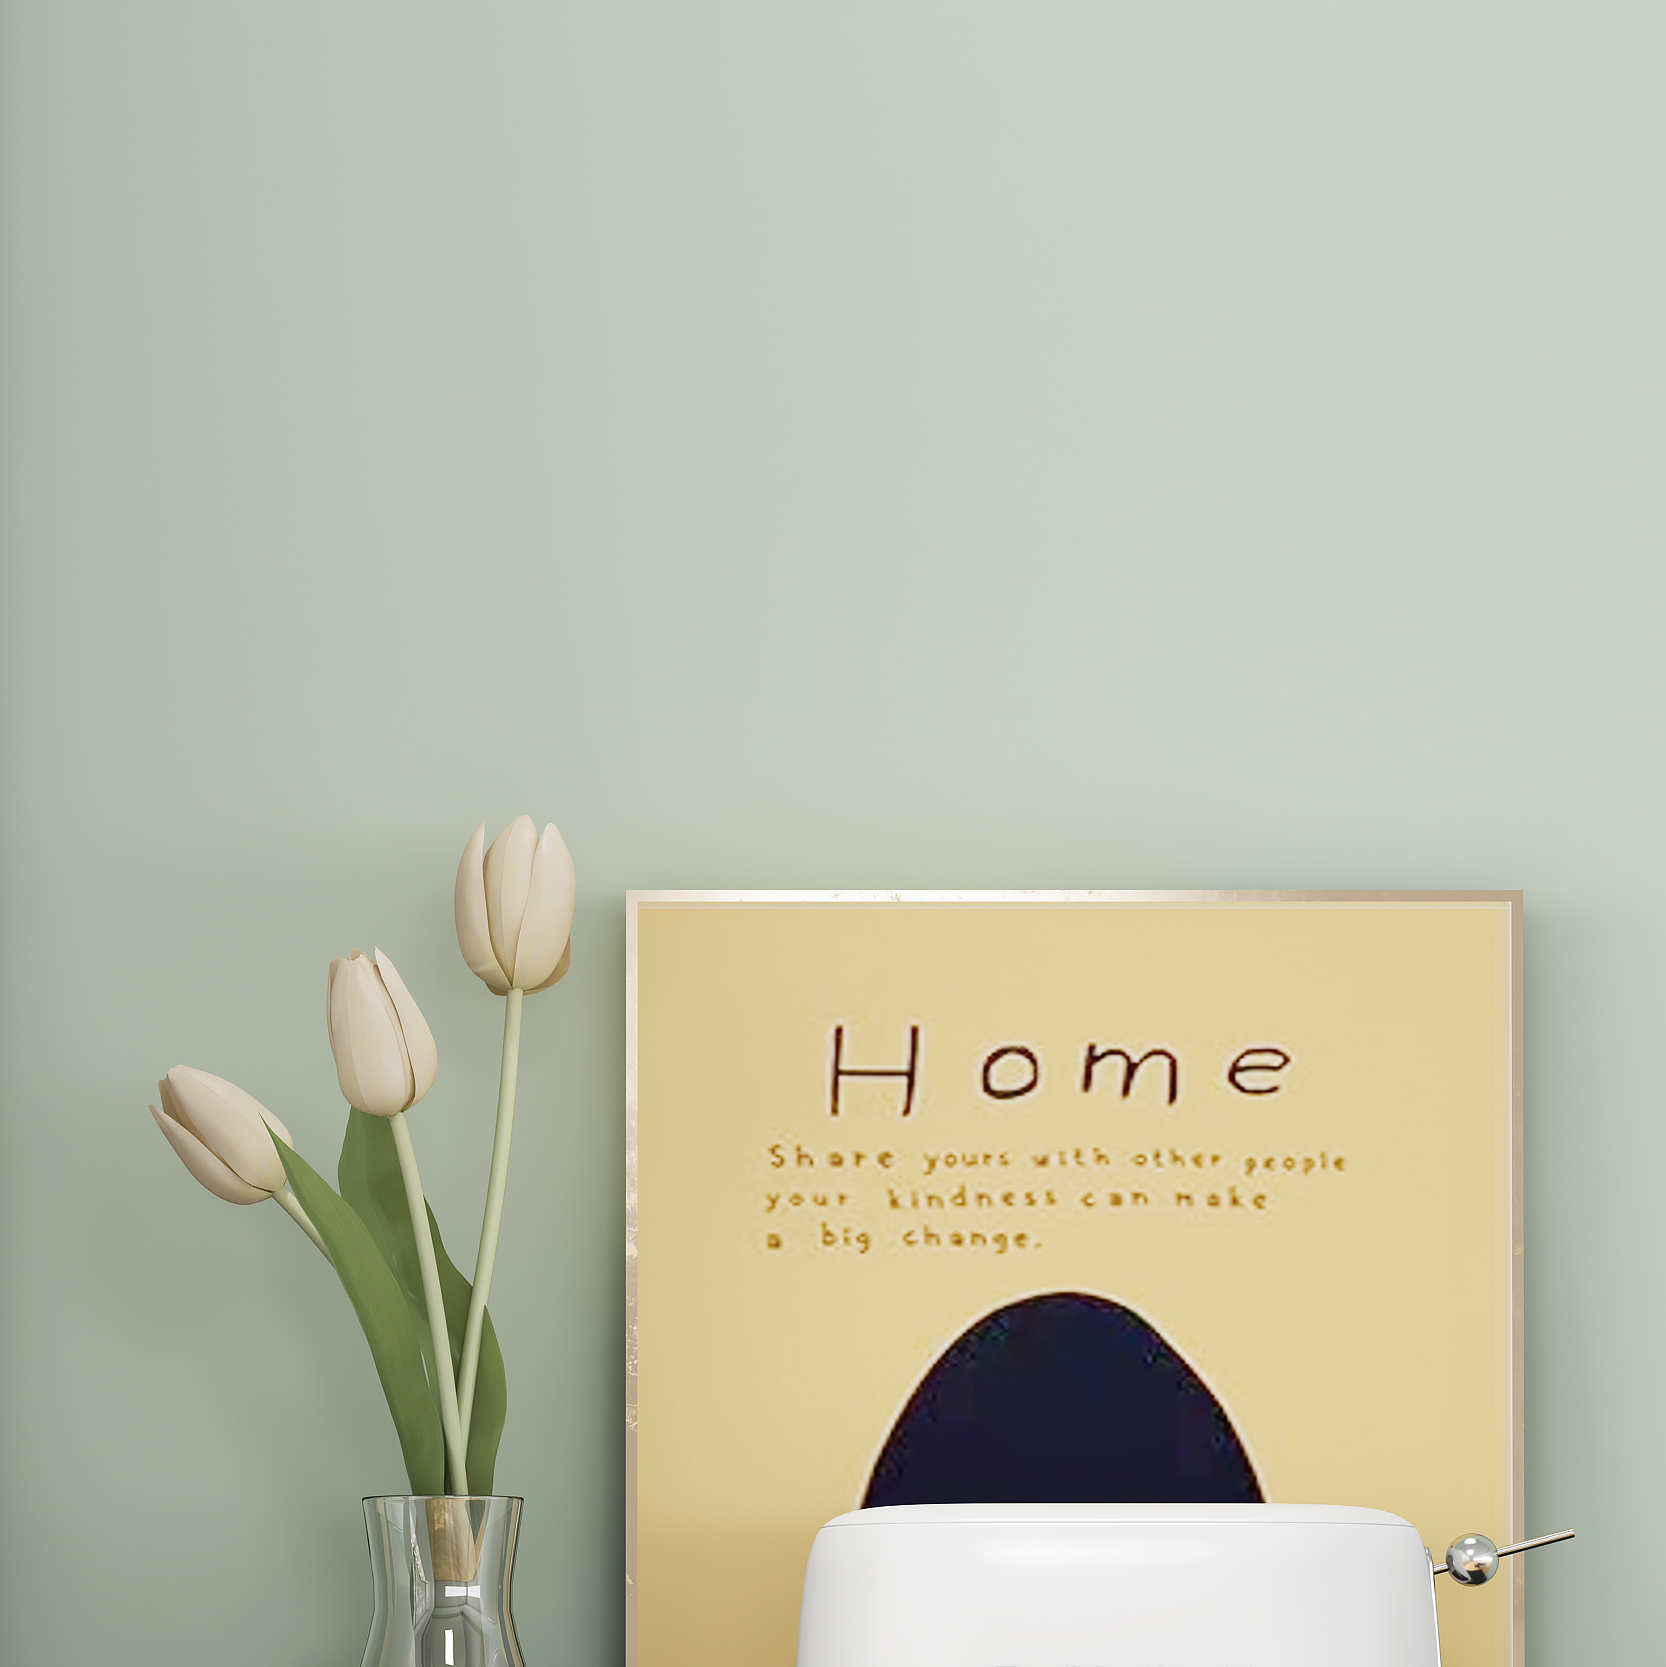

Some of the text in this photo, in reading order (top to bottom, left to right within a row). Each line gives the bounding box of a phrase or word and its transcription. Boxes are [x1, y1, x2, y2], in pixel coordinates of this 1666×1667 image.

[830, 1022, 1292, 1117] Home
[767, 1144, 1347, 1176] Share yours with other people
[765, 1183, 1267, 1214] your kindness can make
[766, 1220, 1044, 1255] a big change.
